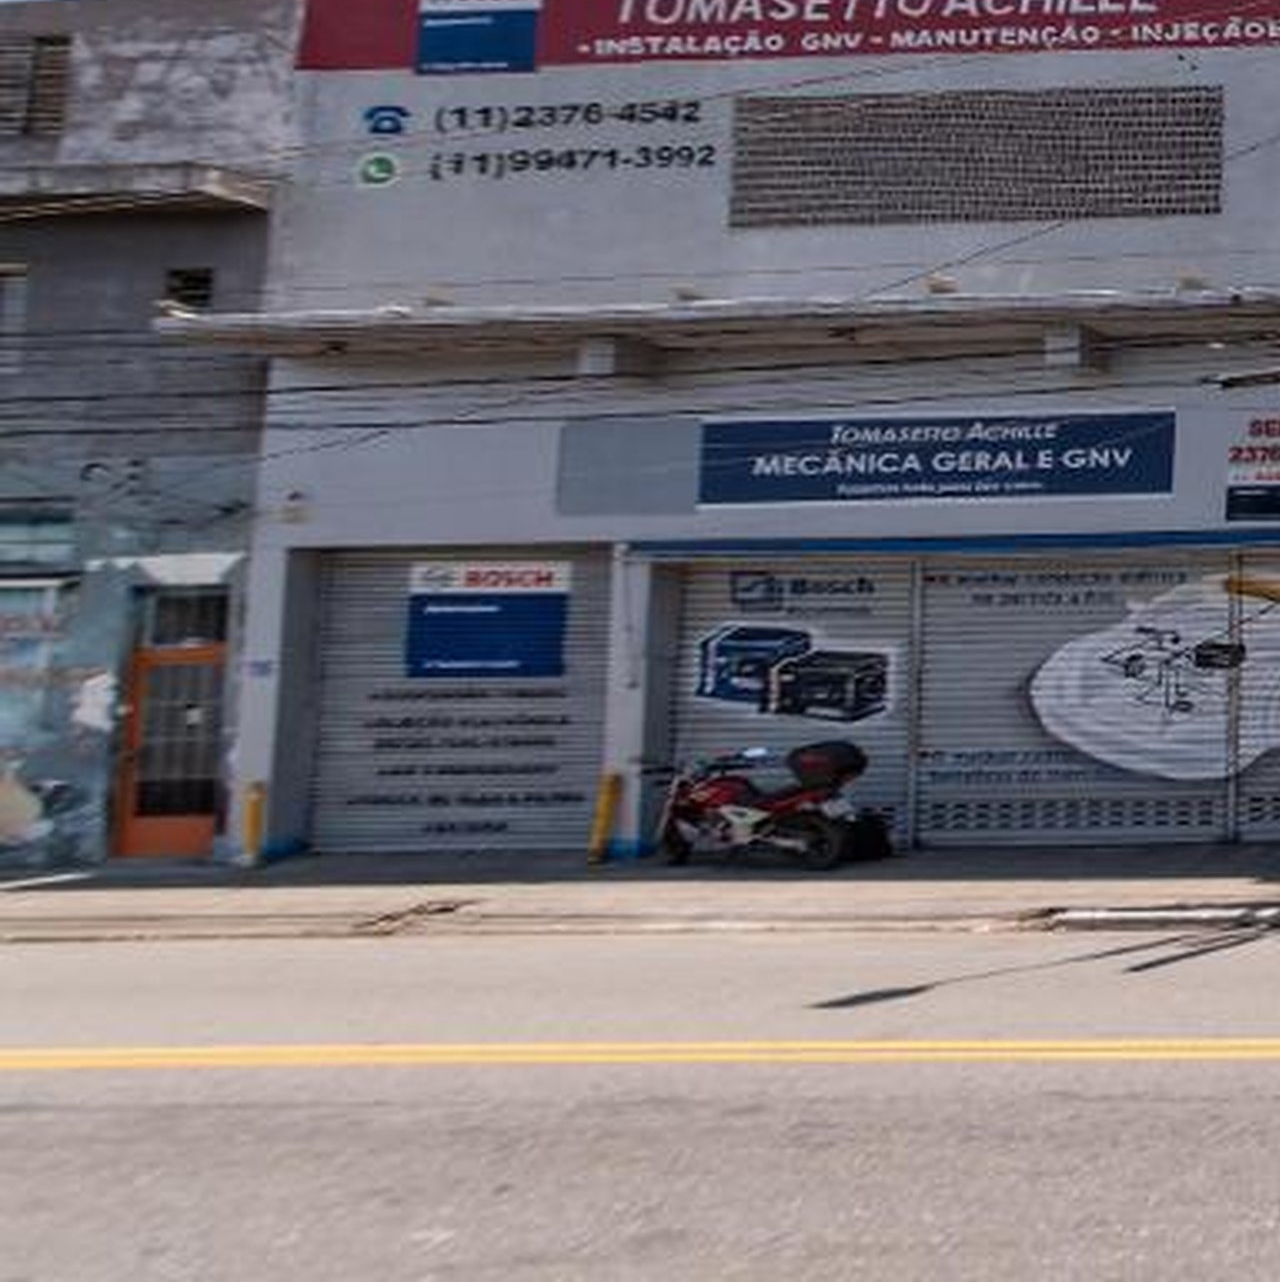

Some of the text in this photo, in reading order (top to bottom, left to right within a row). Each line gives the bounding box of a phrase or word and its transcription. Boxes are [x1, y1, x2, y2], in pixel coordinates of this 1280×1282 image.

[594, 30, 785, 56] INSTALAÇÃO
[801, 30, 864, 51] GNV
[889, 21, 1101, 49] MANUTENÇÃO
[752, 448, 1133, 476] MECÂNICA GERAL E GNV
[464, 570, 554, 588] BOSCH
